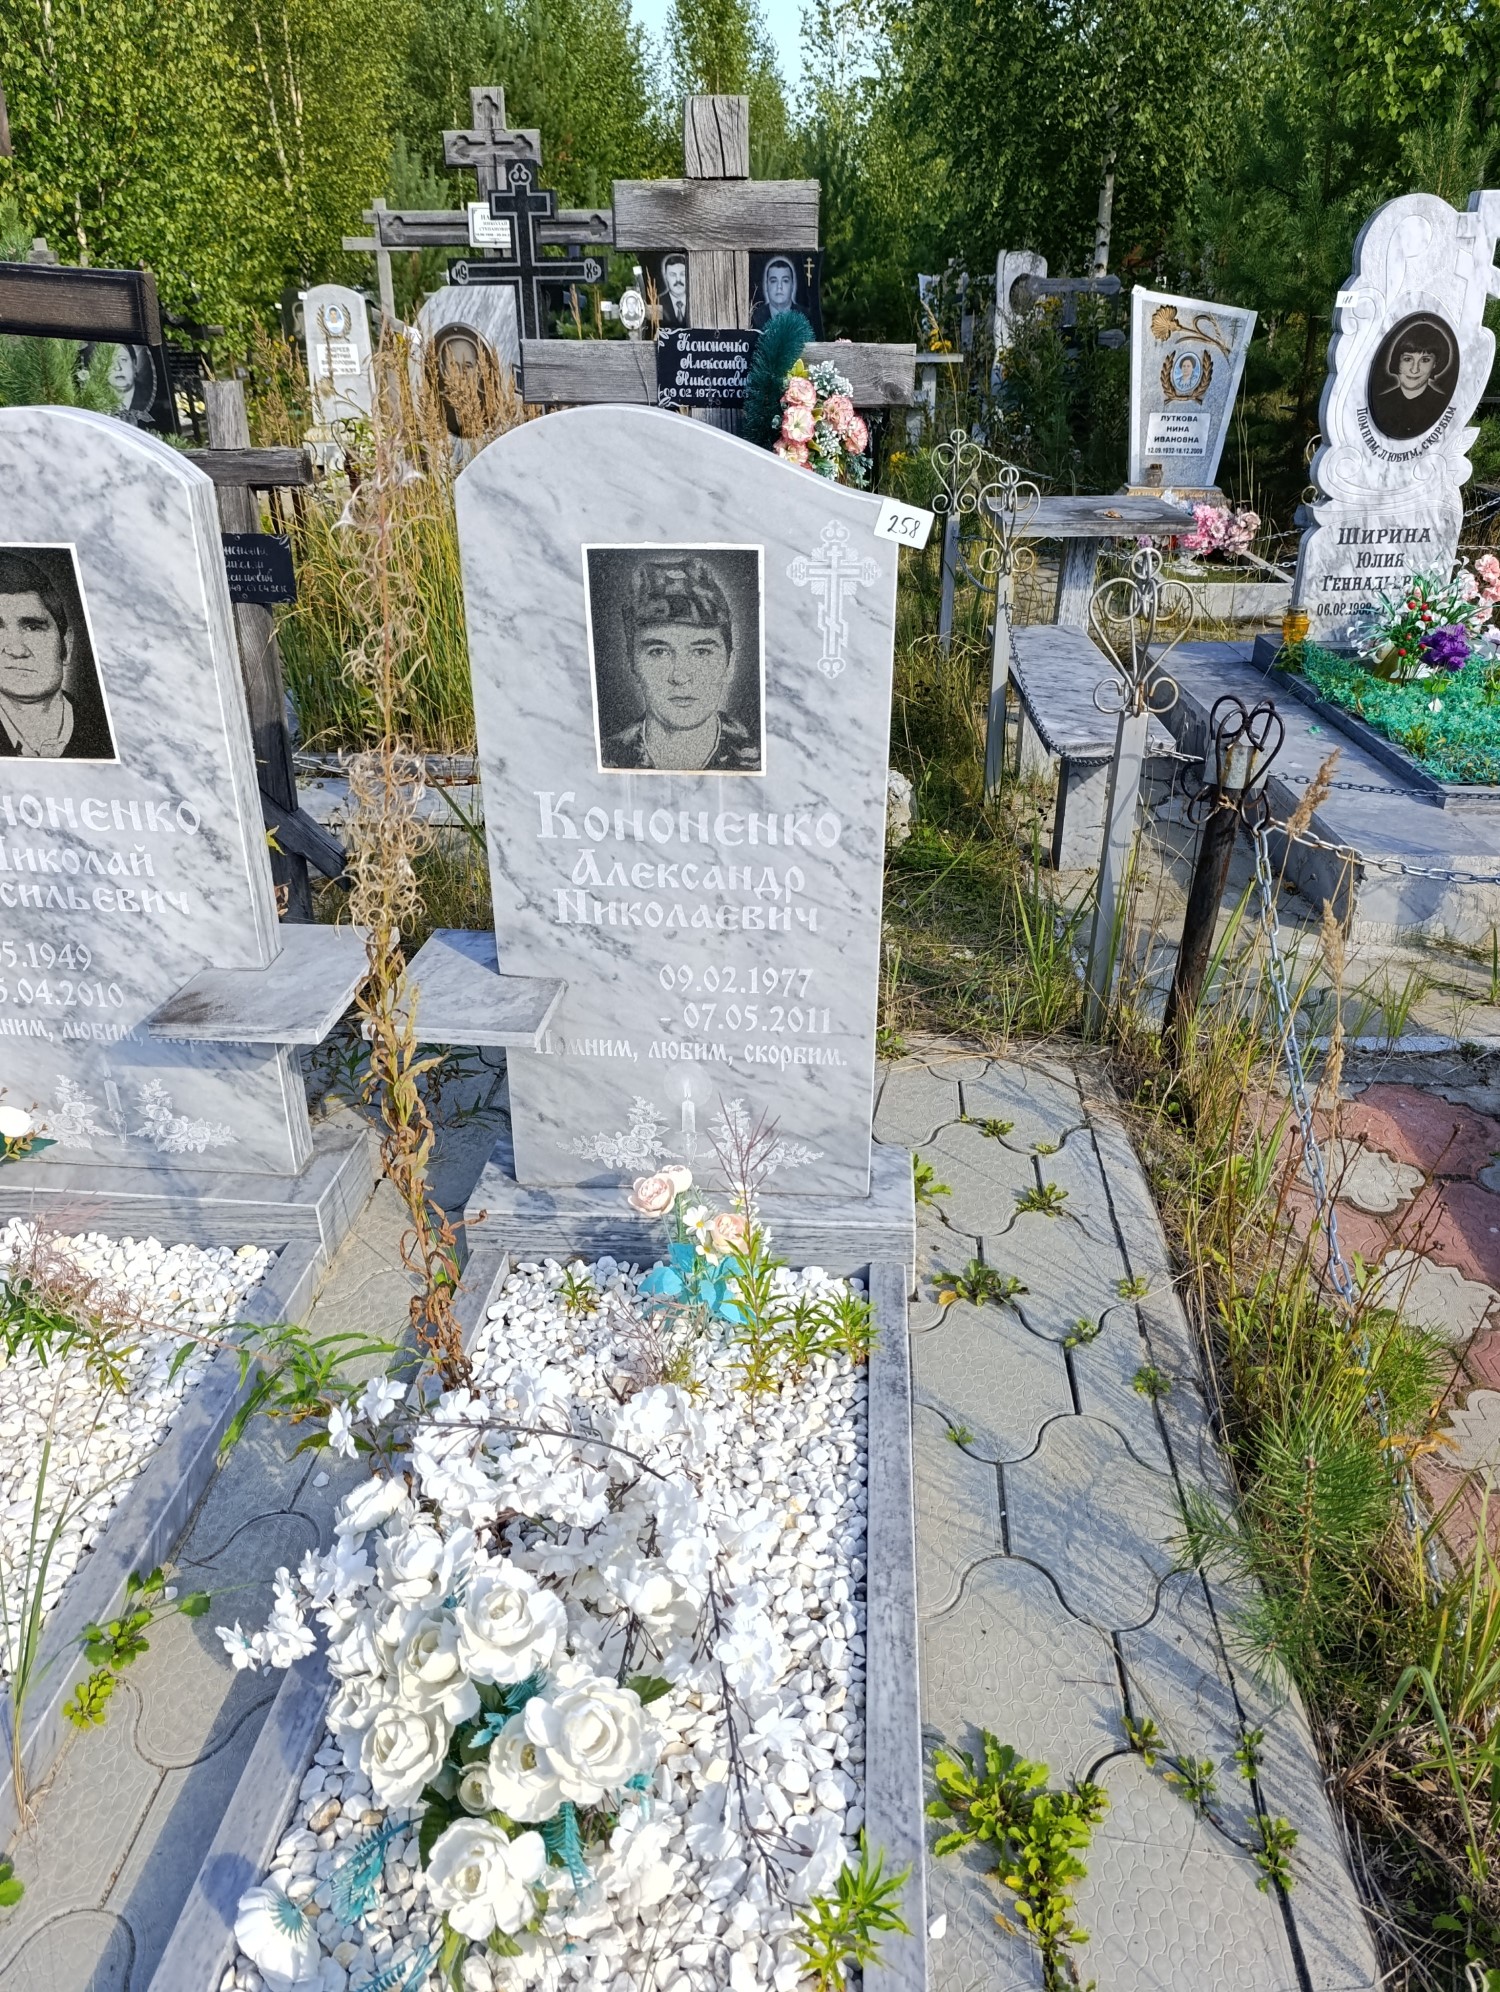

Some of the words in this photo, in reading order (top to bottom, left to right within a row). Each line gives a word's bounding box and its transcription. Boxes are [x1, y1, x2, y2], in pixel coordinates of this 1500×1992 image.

[677, 333, 749, 353] Кононенко
[887, 515, 921, 539] 258
[1337, 527, 1431, 545] ШИРИНА
[1355, 551, 1405, 568] ЮЛИЯ
[533, 791, 842, 848] Кононенко
[571, 849, 805, 903] Александр
[552, 888, 817, 932] Николаевич
[659, 964, 814, 998] 09.02.1977
[683, 1002, 832, 1034] 07.05.2011
[648, 1039, 733, 1065] любим,
[744, 1043, 848, 1071] скорбим.
